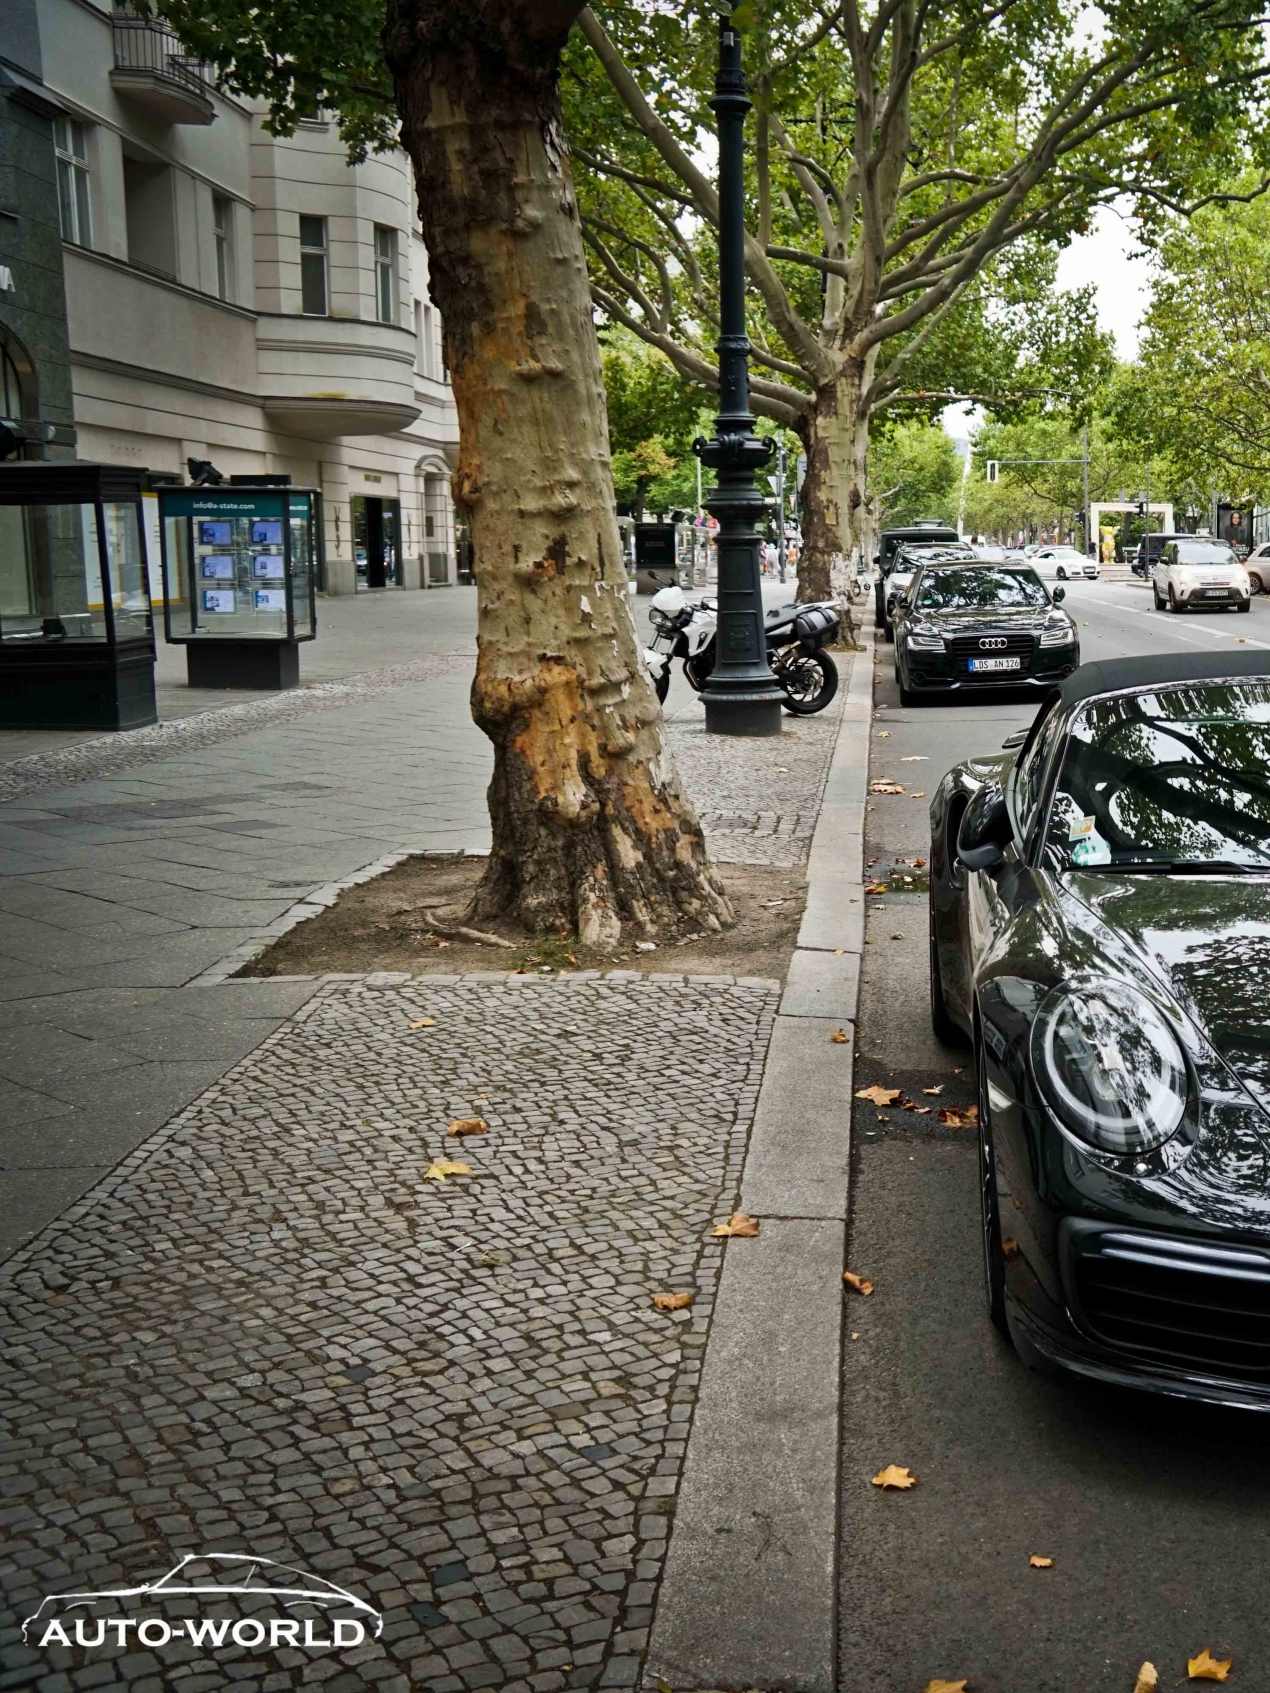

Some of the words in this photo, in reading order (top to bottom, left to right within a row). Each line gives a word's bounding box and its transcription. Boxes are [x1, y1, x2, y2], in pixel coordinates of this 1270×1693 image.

[193, 501, 255, 510] info@a-state.com
[974, 661, 988, 669] LDS
[994, 660, 1004, 668] AN
[1005, 659, 1019, 668] 126
